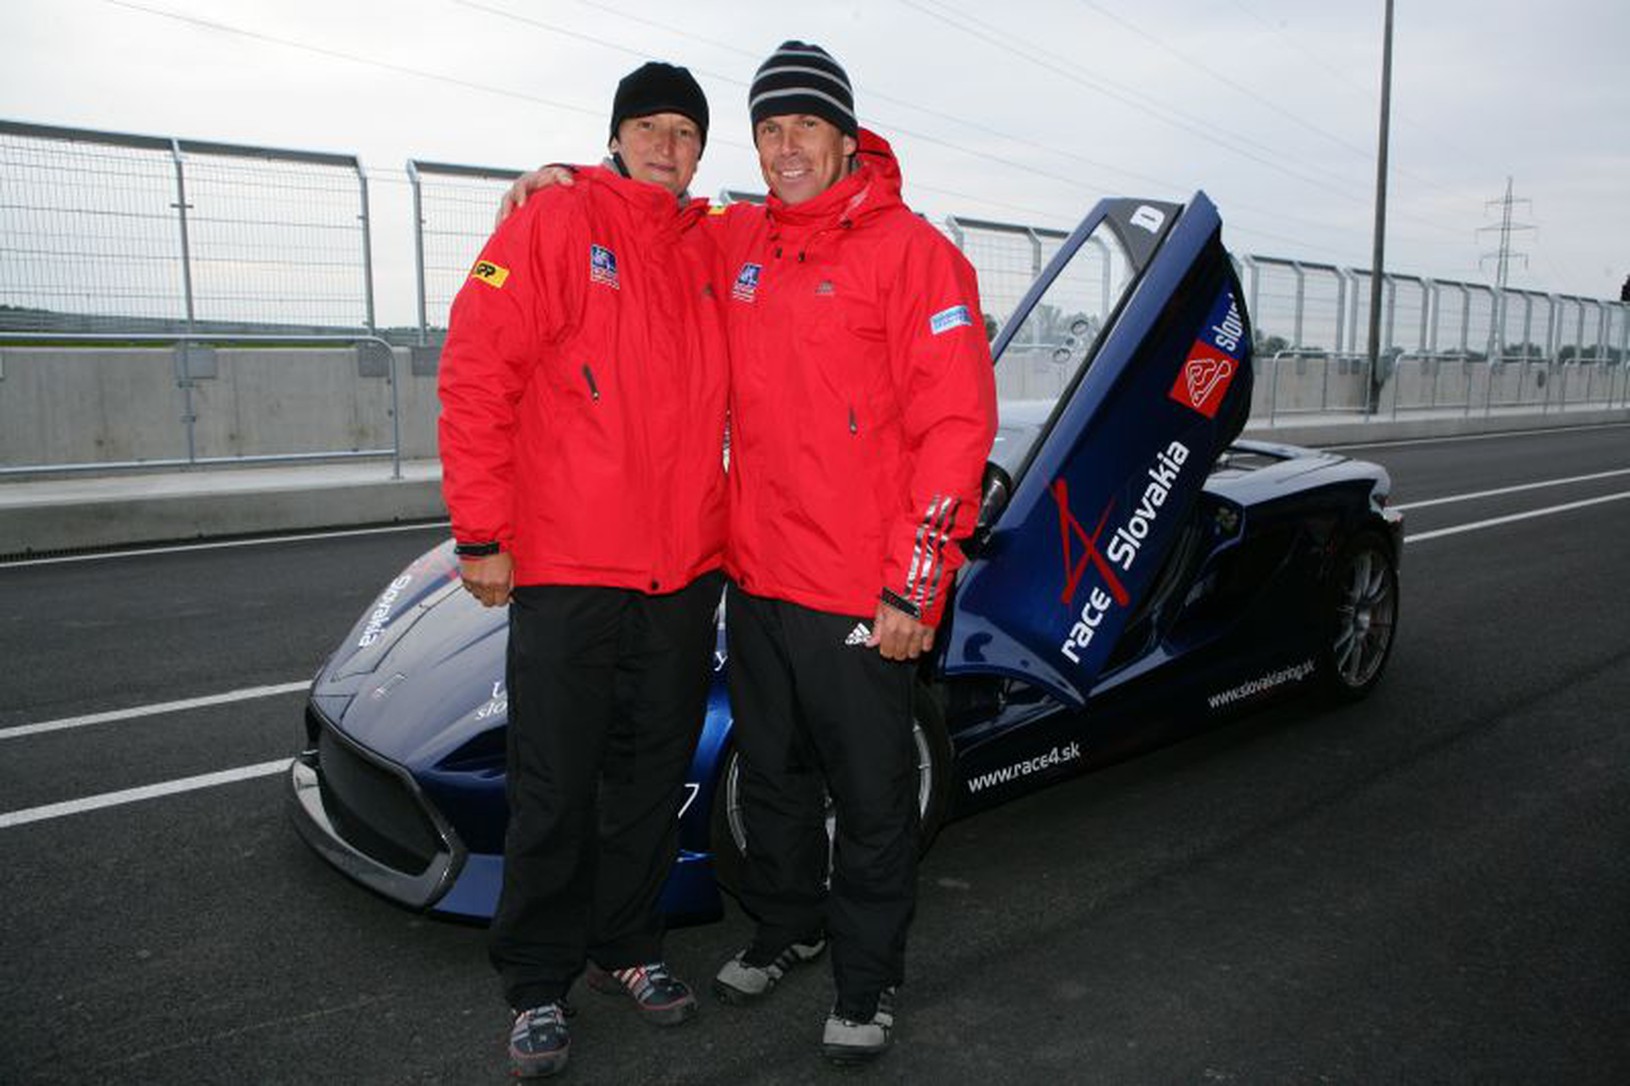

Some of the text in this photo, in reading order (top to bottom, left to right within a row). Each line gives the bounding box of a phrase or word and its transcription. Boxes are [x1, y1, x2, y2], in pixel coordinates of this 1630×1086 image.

[1061, 586, 1112, 664] race
[1107, 440, 1191, 572] Slovakia
[967, 741, 1081, 793] www.race4.sk
